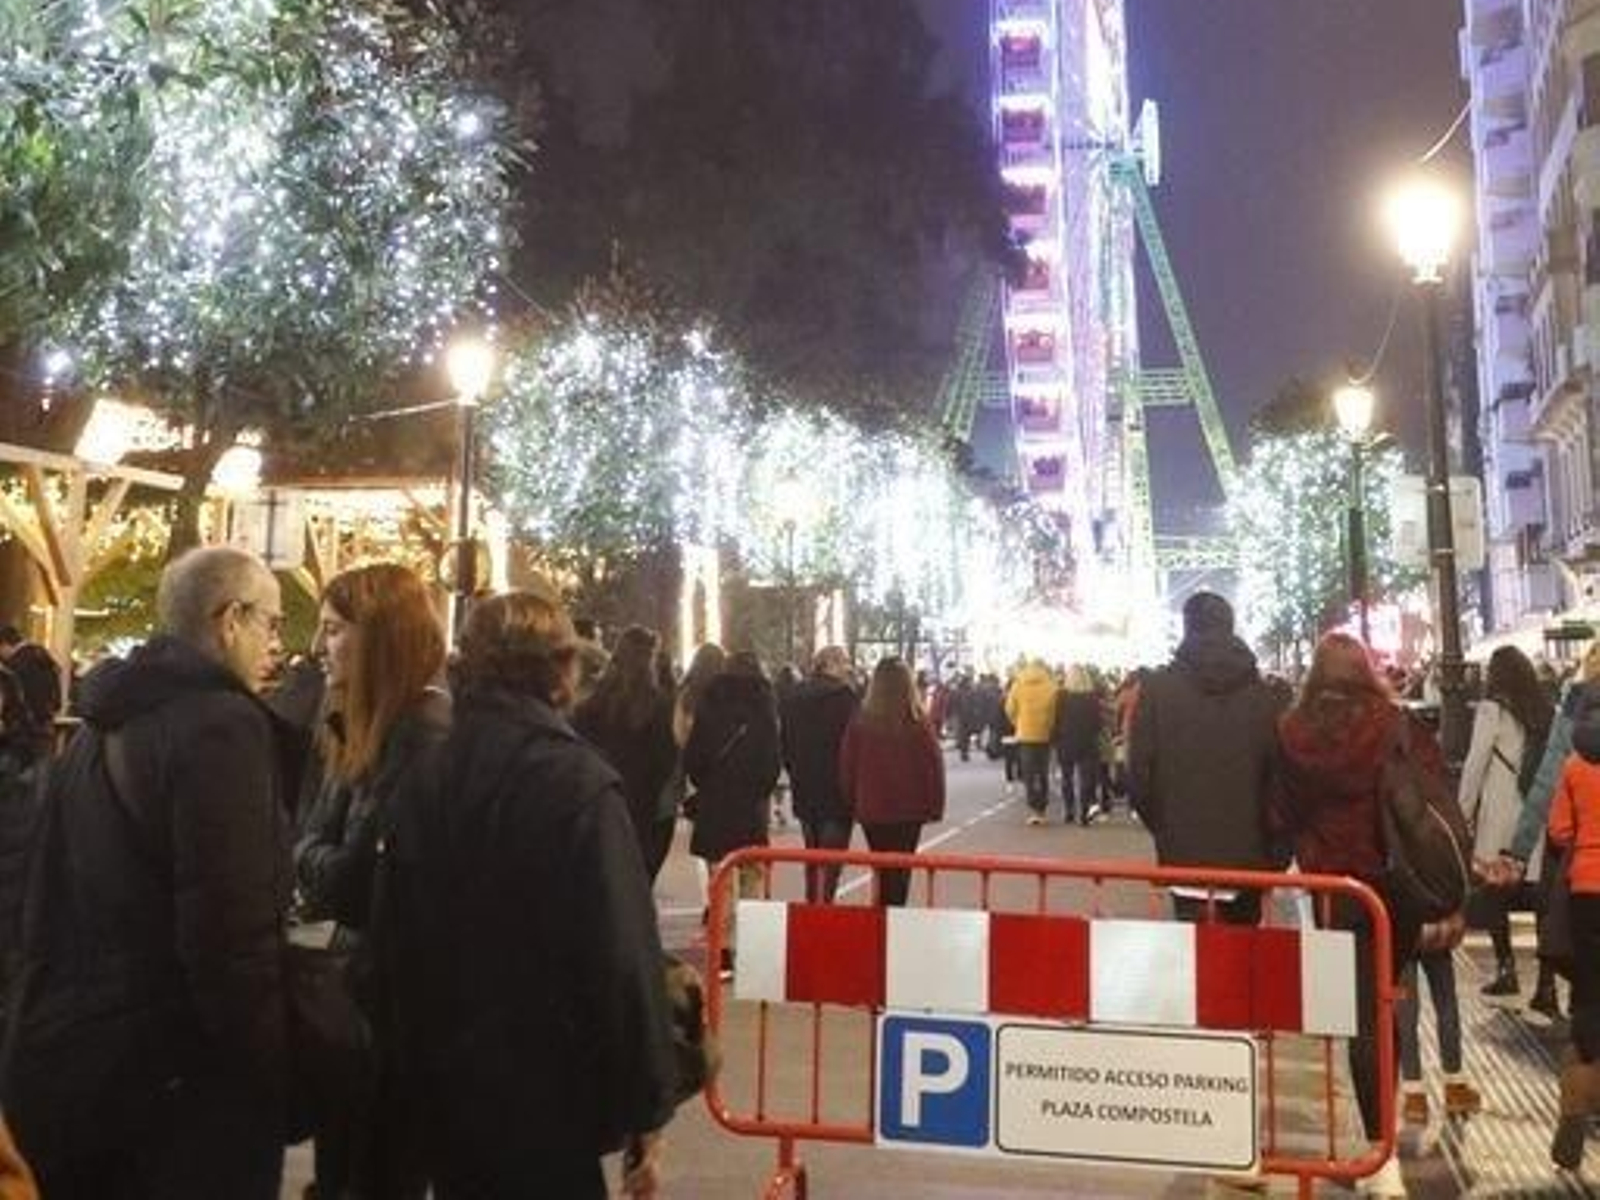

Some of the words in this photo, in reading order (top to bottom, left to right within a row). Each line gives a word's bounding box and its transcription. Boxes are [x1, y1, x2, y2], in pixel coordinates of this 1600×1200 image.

[901, 1030, 970, 1128] P
[1005, 1061, 1100, 1085] PERMITIDO
[1104, 1069, 1170, 1091] ACCESO
[1173, 1075, 1249, 1094] PARKING
[1041, 1100, 1094, 1120] PLAZA
[1098, 1105, 1213, 1127] COMPOSTELA
